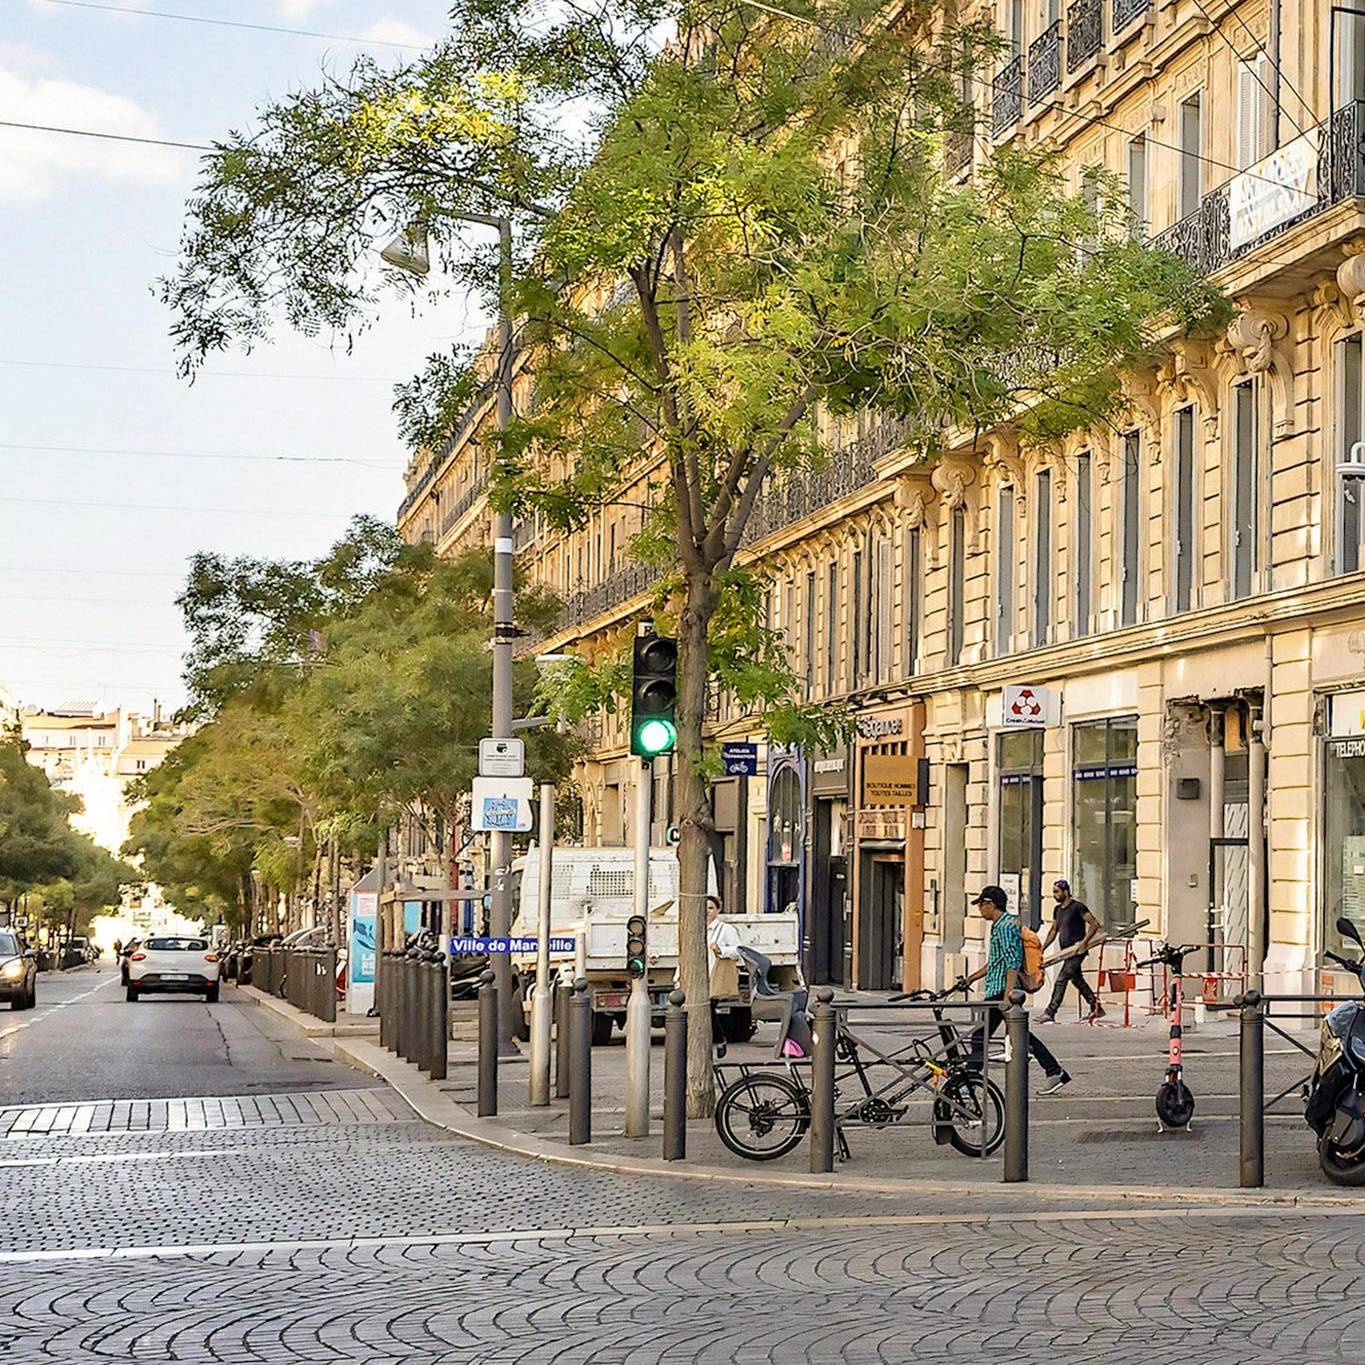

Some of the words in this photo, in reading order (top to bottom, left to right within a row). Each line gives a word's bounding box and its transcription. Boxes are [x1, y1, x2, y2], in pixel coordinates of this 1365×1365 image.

[453, 939, 485, 952] Ville
[488, 939, 506, 952] de
[509, 939, 573, 951] Marille
